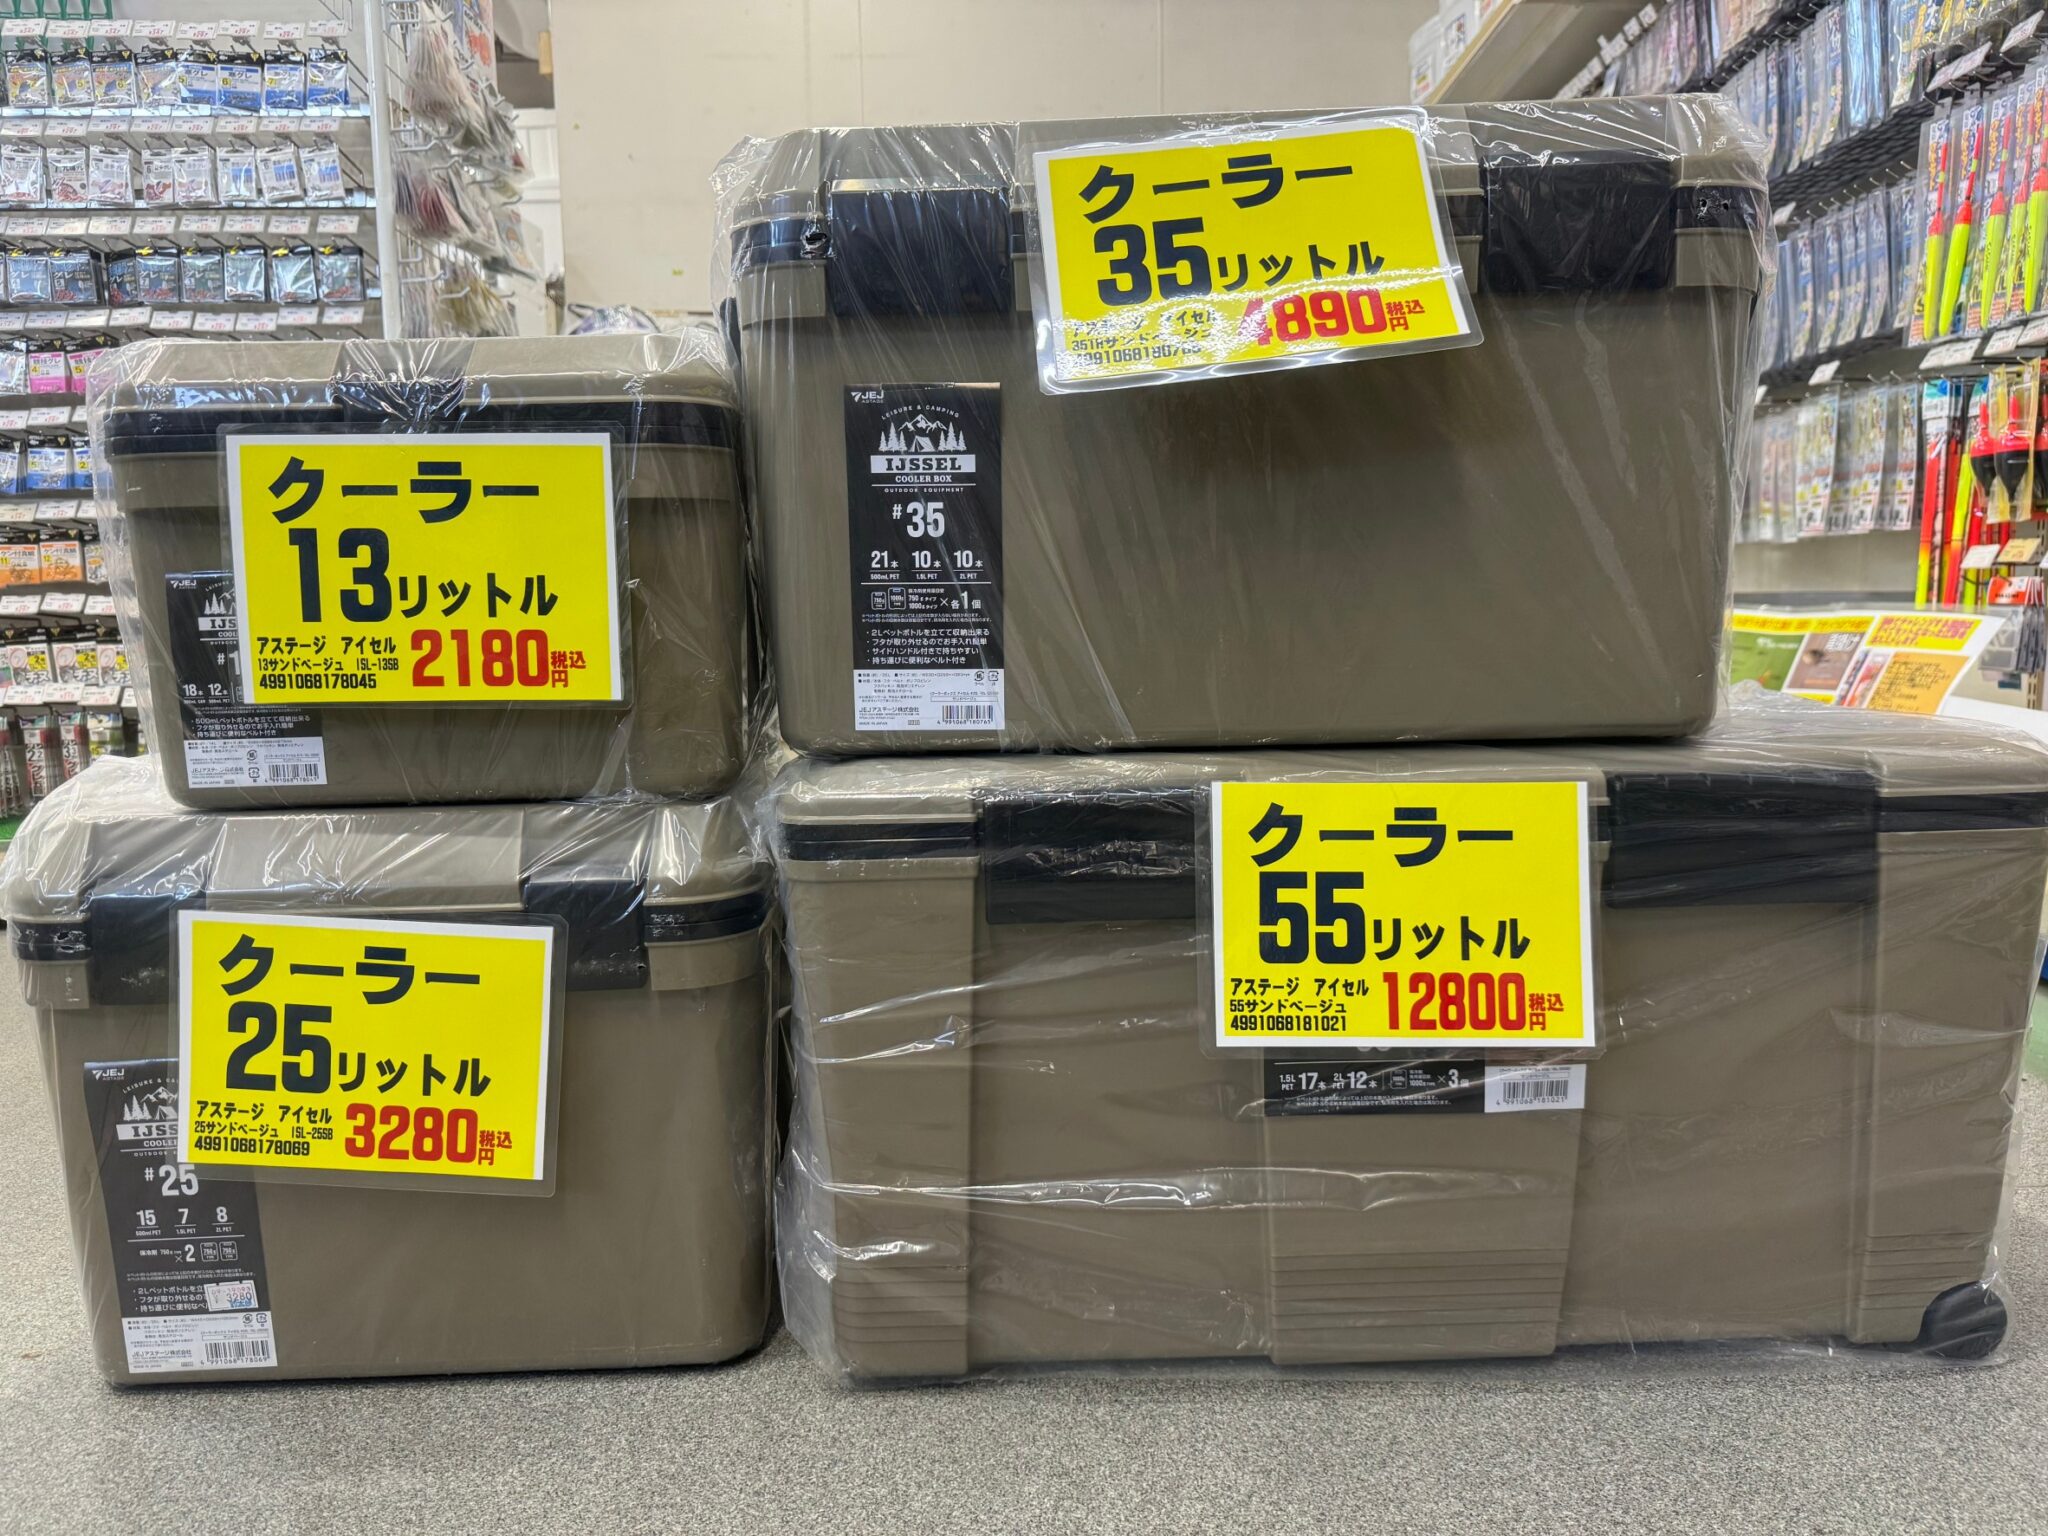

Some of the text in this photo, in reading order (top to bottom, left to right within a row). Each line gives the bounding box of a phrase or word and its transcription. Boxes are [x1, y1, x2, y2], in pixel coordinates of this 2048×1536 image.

[1079, 153, 1353, 224] クーラー
[1239, 288, 1388, 346] 4890
[1387, 299, 1425, 316] 税込
[1390, 316, 1409, 333] 円
[861, 391, 884, 399] JEJ
[881, 405, 913, 420] LEISURE
[926, 405, 960, 418] CAMPING
[886, 458, 962, 471] IJSSEL
[895, 475, 952, 483] COOLER BOX
[268, 456, 539, 524] クーラー
[288, 527, 559, 623] 13リットル
[256, 635, 397, 655] アステージ アイセル
[257, 657, 399, 673] 13サンドベージュ ISL-13SB
[410, 628, 549, 687] 2180
[550, 650, 586, 669] 税込
[258, 672, 377, 690] 4991068178045
[551, 669, 569, 688] 円
[1248, 802, 1513, 868] クーラー
[1258, 871, 1531, 964] 55リットル
[218, 933, 481, 1005] クーラー
[1229, 977, 1370, 997] アステージ アイセル
[1229, 998, 1347, 1014] 55サンドベージュ
[1382, 971, 1526, 1031] 12800
[1529, 992, 1565, 1012] 税込
[1230, 1015, 1347, 1032] 4991068181021
[1529, 1012, 1547, 1031] 円
[226, 1001, 492, 1097] 25リットル
[102, 1069, 125, 1077] JEJ
[122, 1079, 153, 1094] LEISURE
[1281, 1083, 1293, 1091] PET
[196, 1100, 333, 1125] アステージ アイセル
[194, 1121, 333, 1141] 25サンドベージュ ISL-25SB
[345, 1102, 478, 1163] 3280
[478, 1130, 513, 1149] 税込
[194, 1136, 310, 1156] 4991068178069
[478, 1149, 495, 1166] 円
[136, 1206, 228, 1226] 15 7 8
